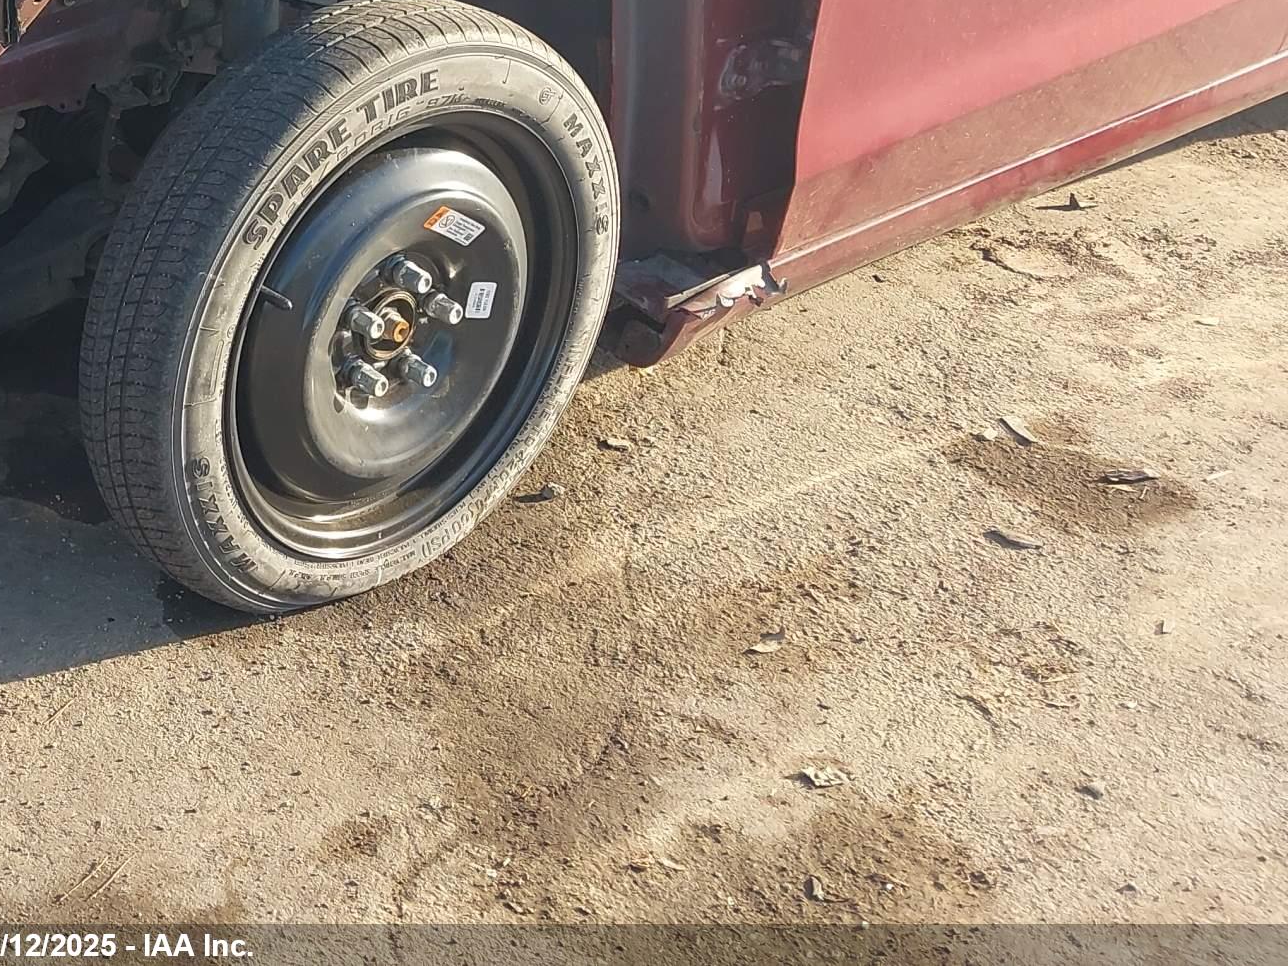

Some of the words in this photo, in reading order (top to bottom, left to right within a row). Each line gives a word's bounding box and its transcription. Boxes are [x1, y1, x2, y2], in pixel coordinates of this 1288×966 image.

[240, 111, 353, 251] SPARE
[355, 68, 441, 126] TIRE
[562, 112, 609, 236] MAXXIS
[192, 456, 260, 575] MAXXIS
